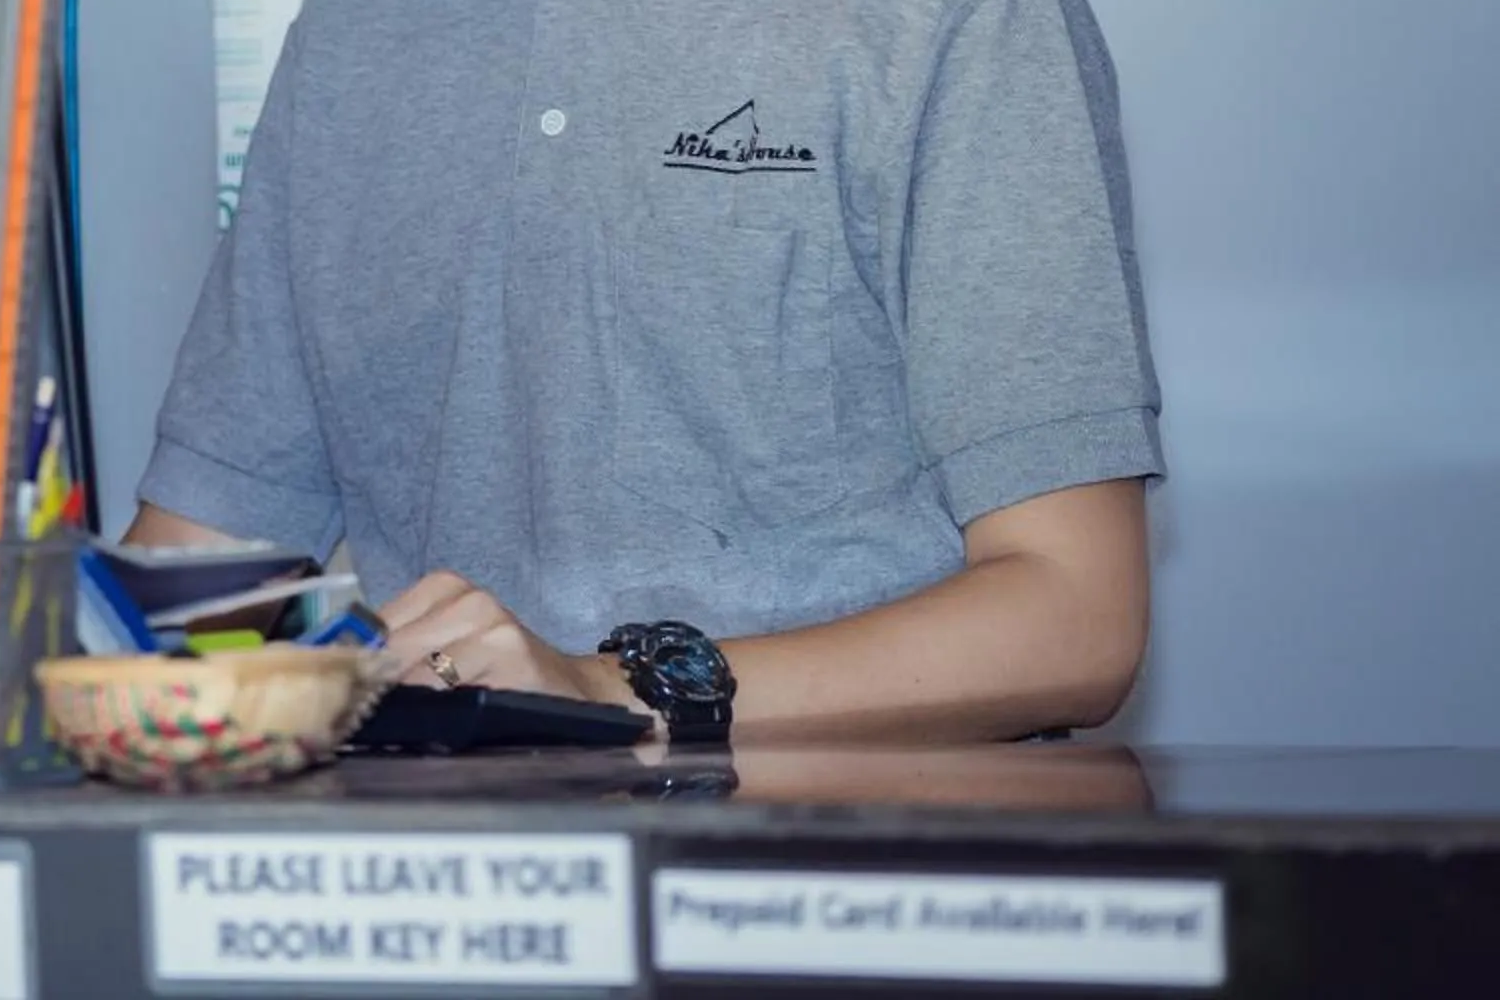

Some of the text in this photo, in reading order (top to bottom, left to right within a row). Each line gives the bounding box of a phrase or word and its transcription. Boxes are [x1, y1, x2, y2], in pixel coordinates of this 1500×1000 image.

[176, 852, 609, 895] PLEASE LEAVE YOUR
[669, 887, 804, 937] Prepaid
[818, 890, 903, 931] Card
[916, 891, 1089, 933] Available
[216, 922, 571, 963] ROOM KEY HERE
